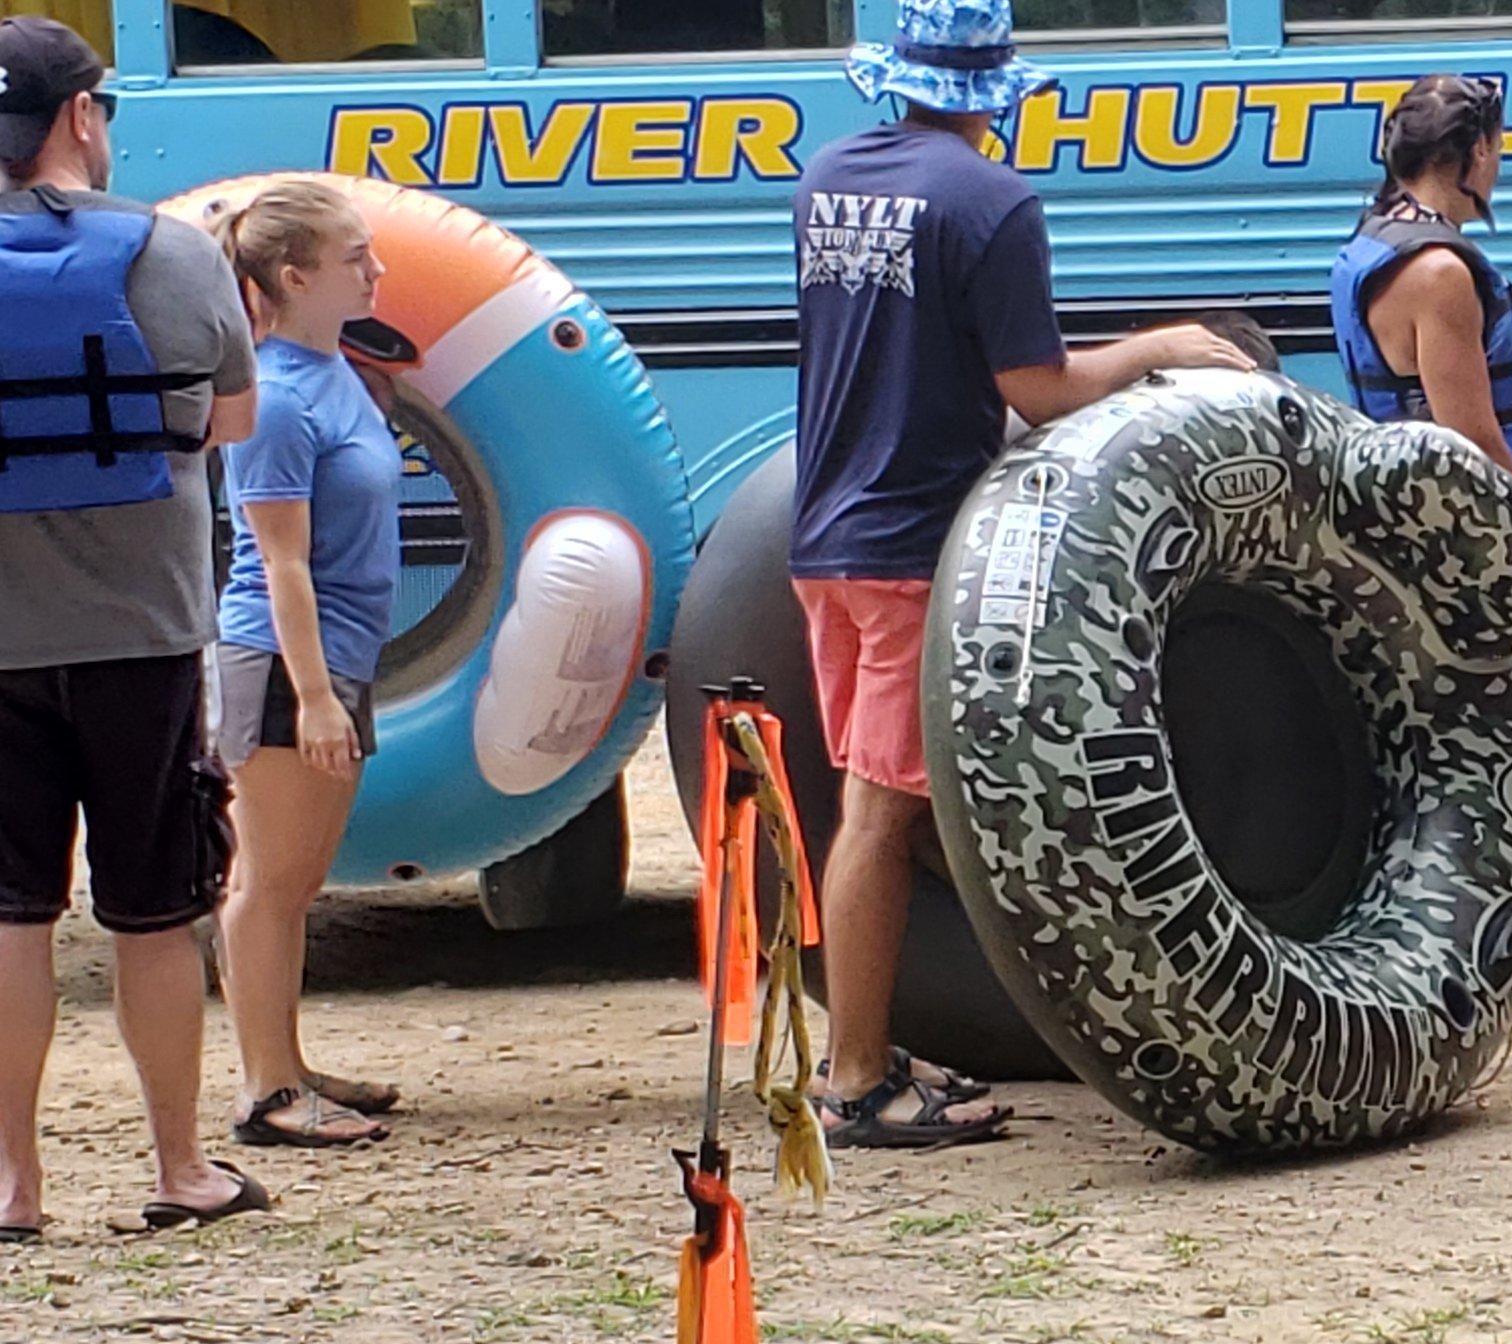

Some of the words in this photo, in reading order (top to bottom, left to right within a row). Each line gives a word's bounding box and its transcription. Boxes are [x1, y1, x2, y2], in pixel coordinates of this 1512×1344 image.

[327, 93, 804, 188] RIVER
[808, 192, 928, 231] NYLT
[1215, 467, 1269, 499] INTEX
[1080, 728, 1273, 1044] RIVER
[1254, 959, 1420, 1109] RUN
